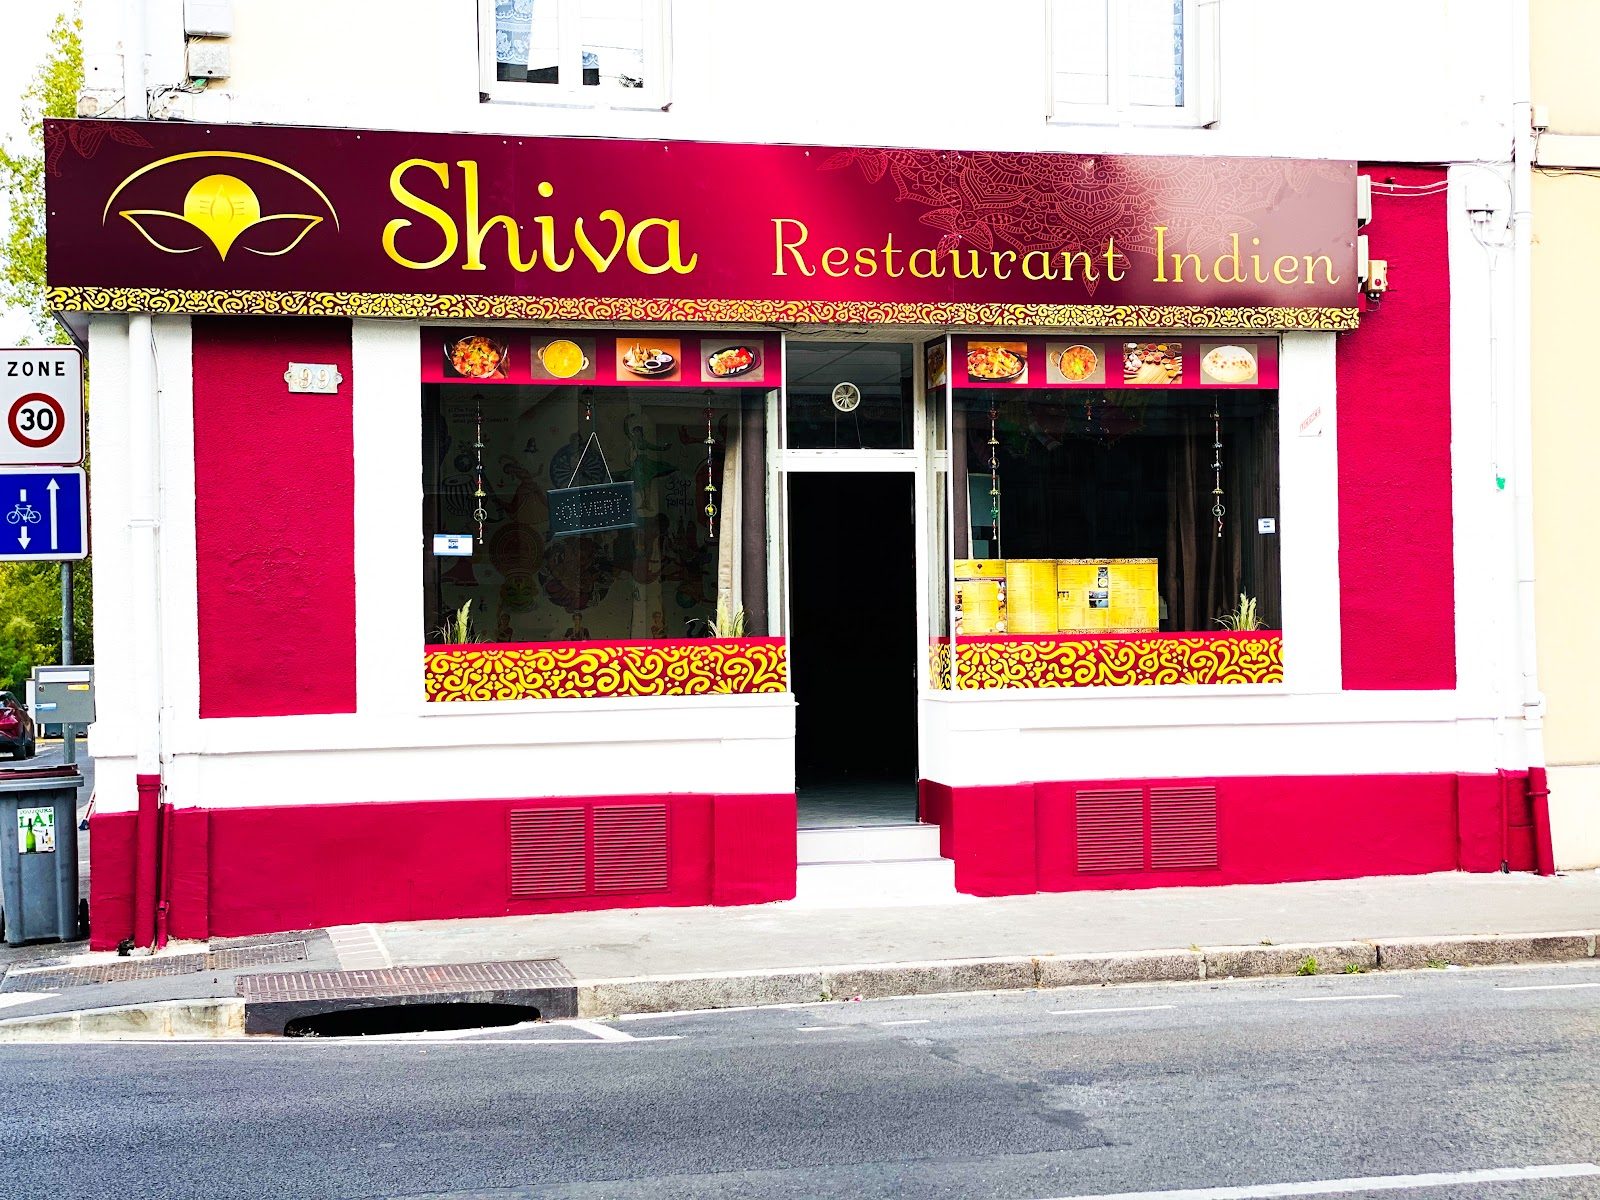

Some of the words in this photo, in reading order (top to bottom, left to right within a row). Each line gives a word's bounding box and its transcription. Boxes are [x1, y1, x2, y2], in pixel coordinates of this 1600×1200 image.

[382, 158, 698, 275] Shiva
[772, 217, 1126, 284] Restaurant
[1151, 225, 1341, 286] Indien
[7, 361, 65, 376] ZONE
[300, 368, 330, 389] 99
[20, 408, 54, 431] 30
[561, 499, 622, 520] OUVERT
